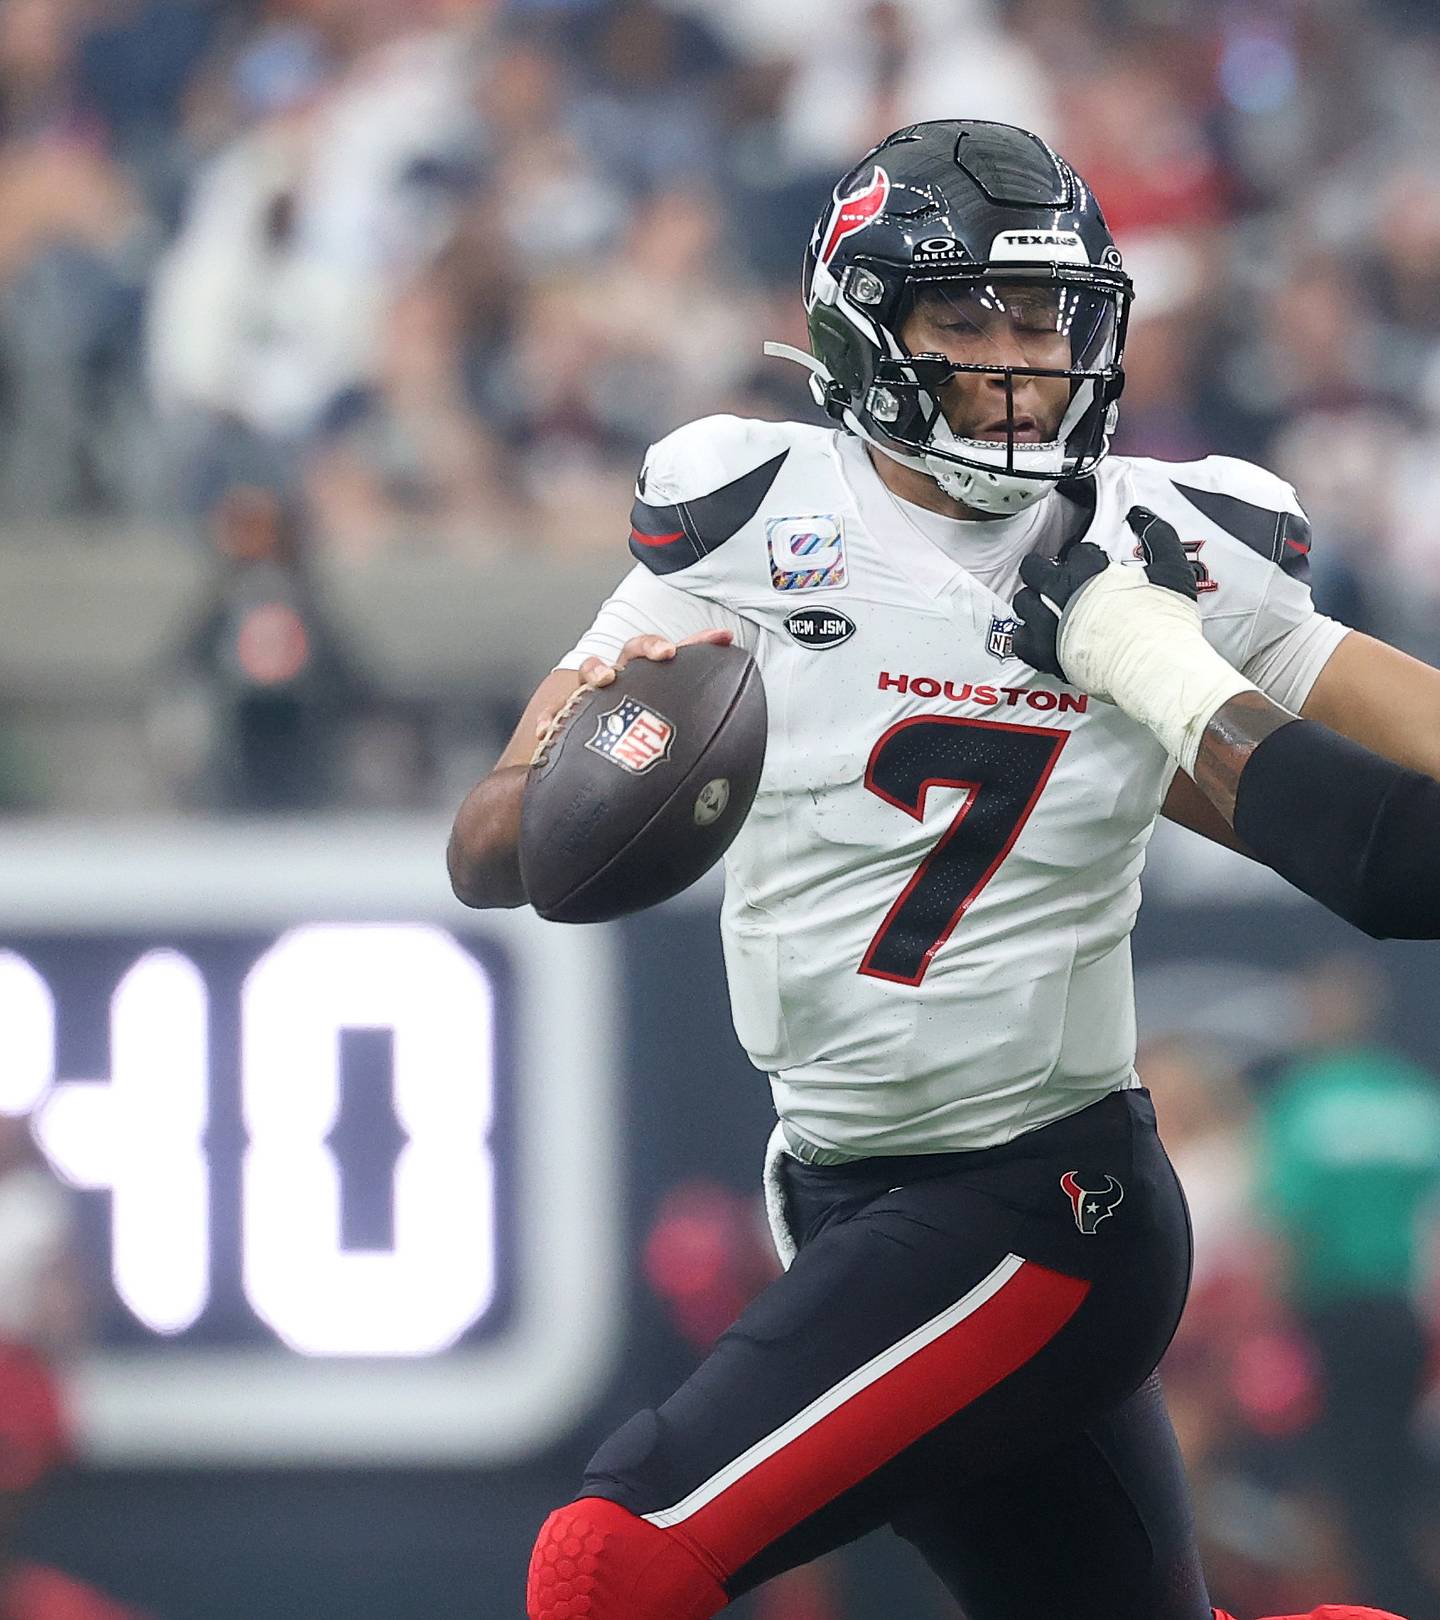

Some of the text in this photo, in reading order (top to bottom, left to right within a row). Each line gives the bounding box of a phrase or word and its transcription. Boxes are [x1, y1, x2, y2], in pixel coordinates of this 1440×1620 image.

[1003, 235, 1078, 247] TEXANS
[914, 250, 965, 262] OAKLEY
[788, 619, 847, 635] RCM JSM
[991, 633, 1013, 654] NF
[877, 671, 1089, 714] HOUSTON
[616, 718, 670, 769] NFL
[856, 712, 1072, 988] 7
